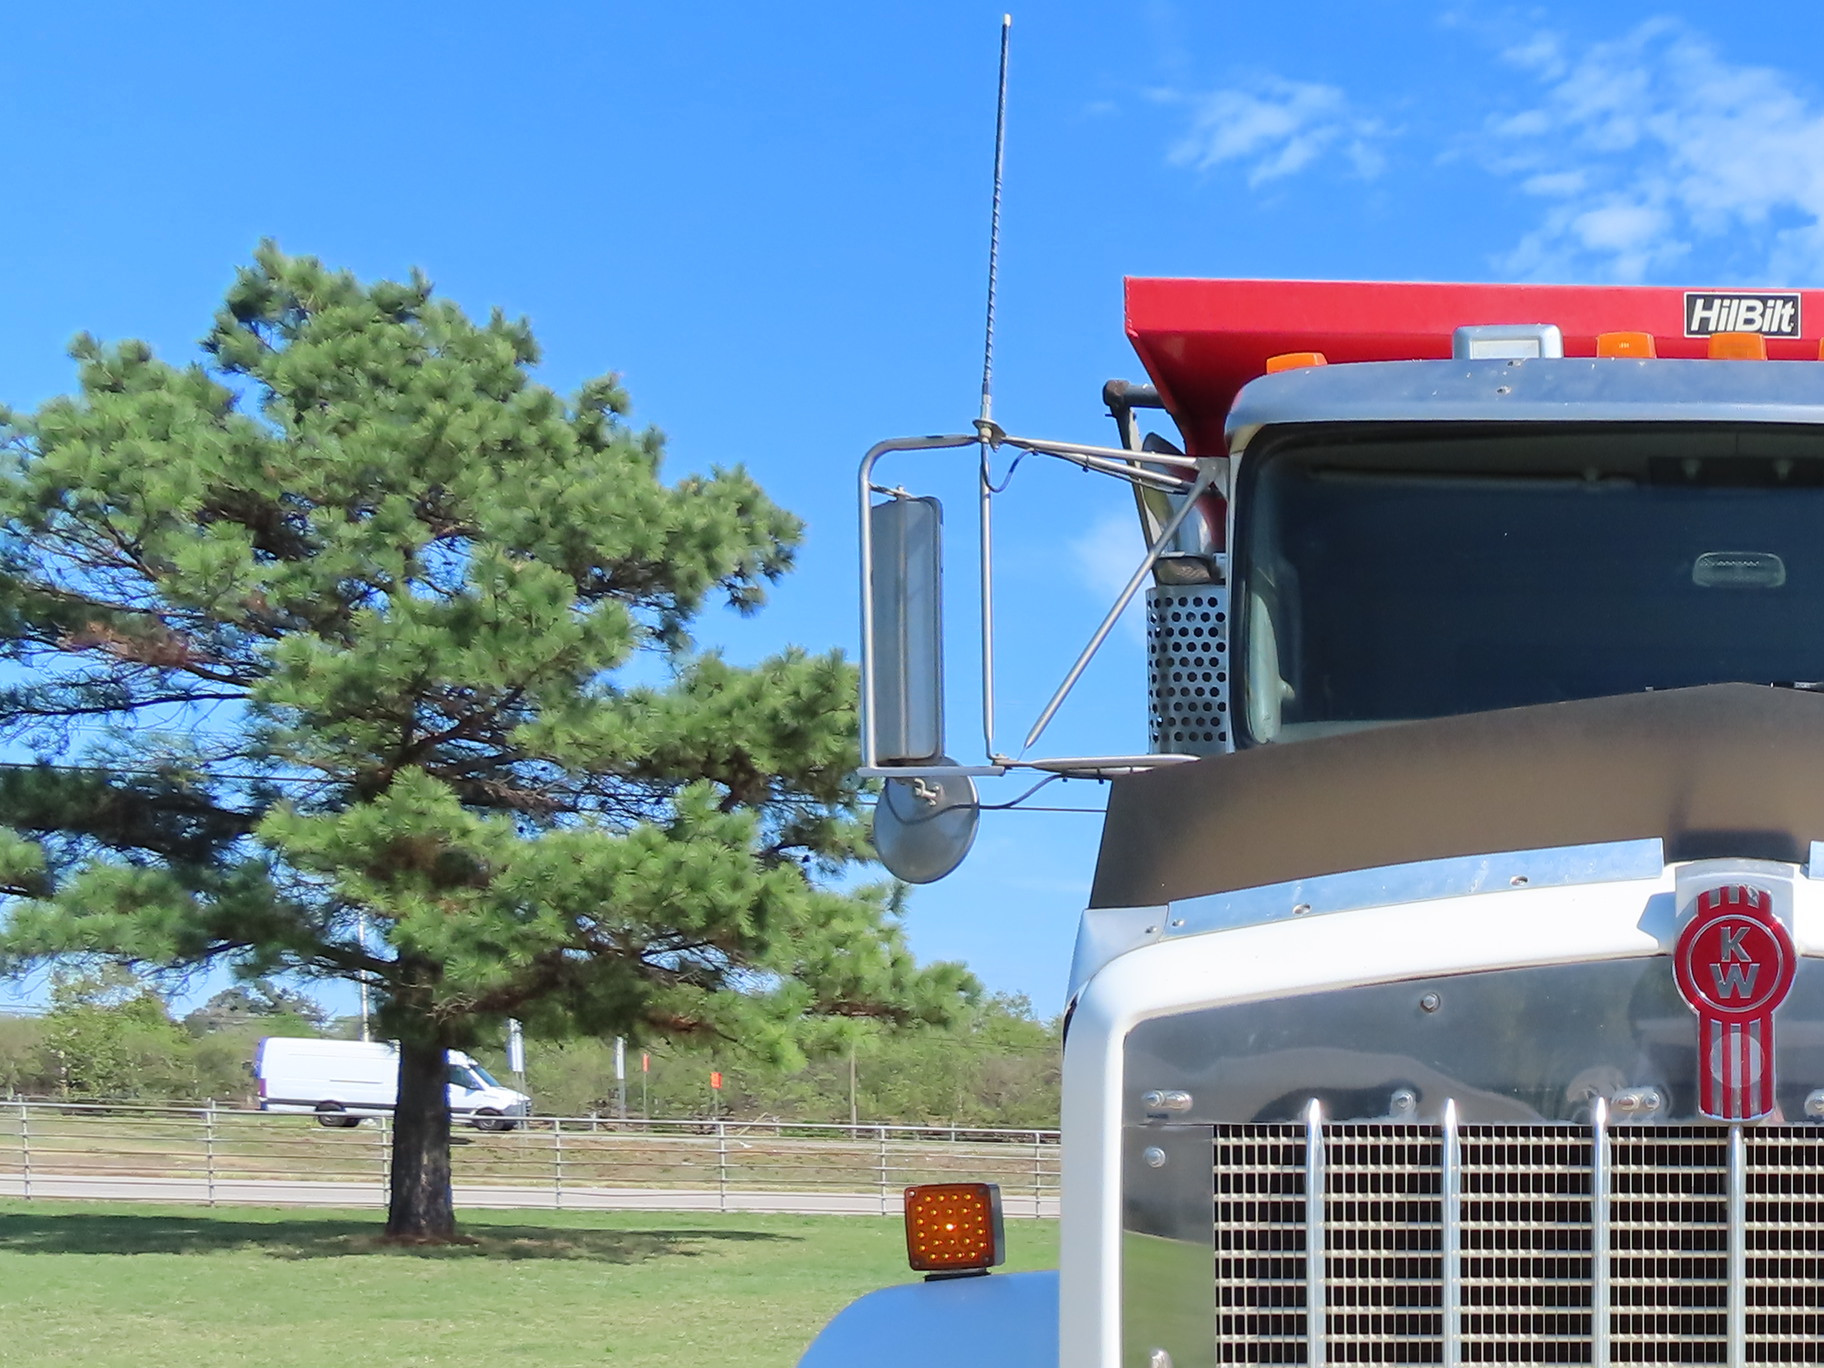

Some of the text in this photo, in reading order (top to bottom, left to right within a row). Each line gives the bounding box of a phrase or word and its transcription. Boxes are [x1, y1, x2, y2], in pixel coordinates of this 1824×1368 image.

[1690, 298, 1795, 333] HilBilt
[1720, 926, 1751, 962] K
[1709, 963, 1760, 998] W
